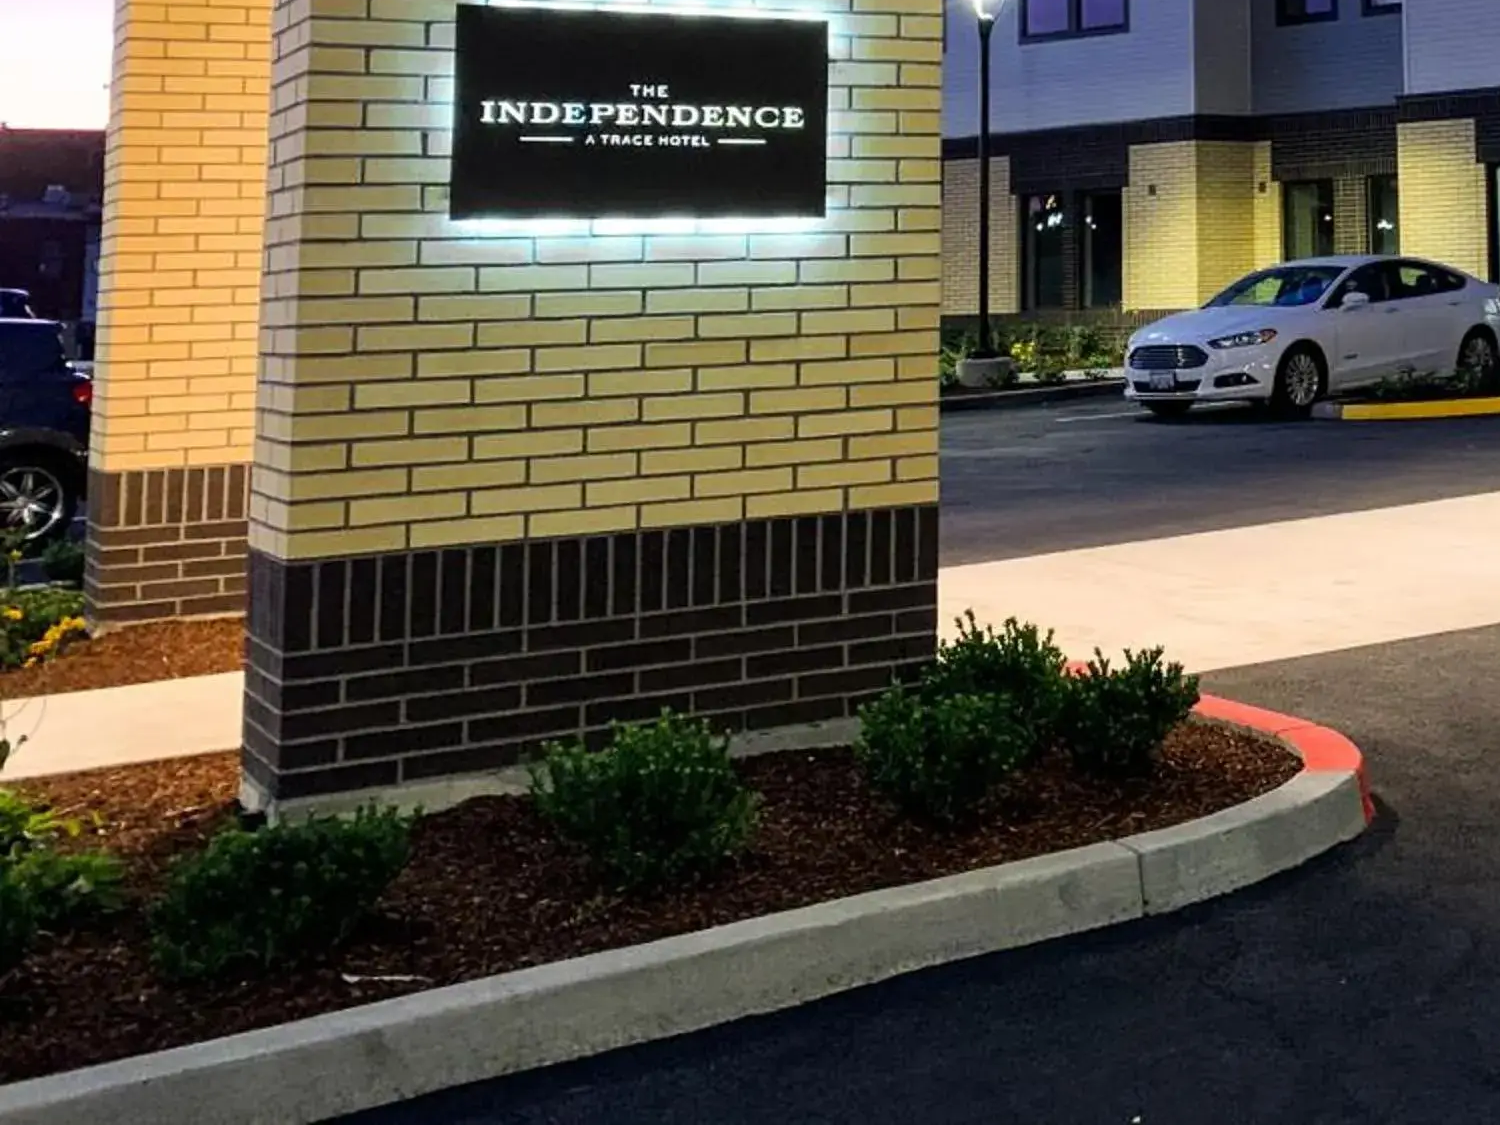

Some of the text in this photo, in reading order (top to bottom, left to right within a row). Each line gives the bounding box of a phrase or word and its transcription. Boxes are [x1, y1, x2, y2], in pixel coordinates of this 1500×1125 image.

[629, 84, 669, 98] THE
[480, 100, 805, 128] INDEPENDENCE
[585, 134, 711, 147] A TRACE HOTEL
